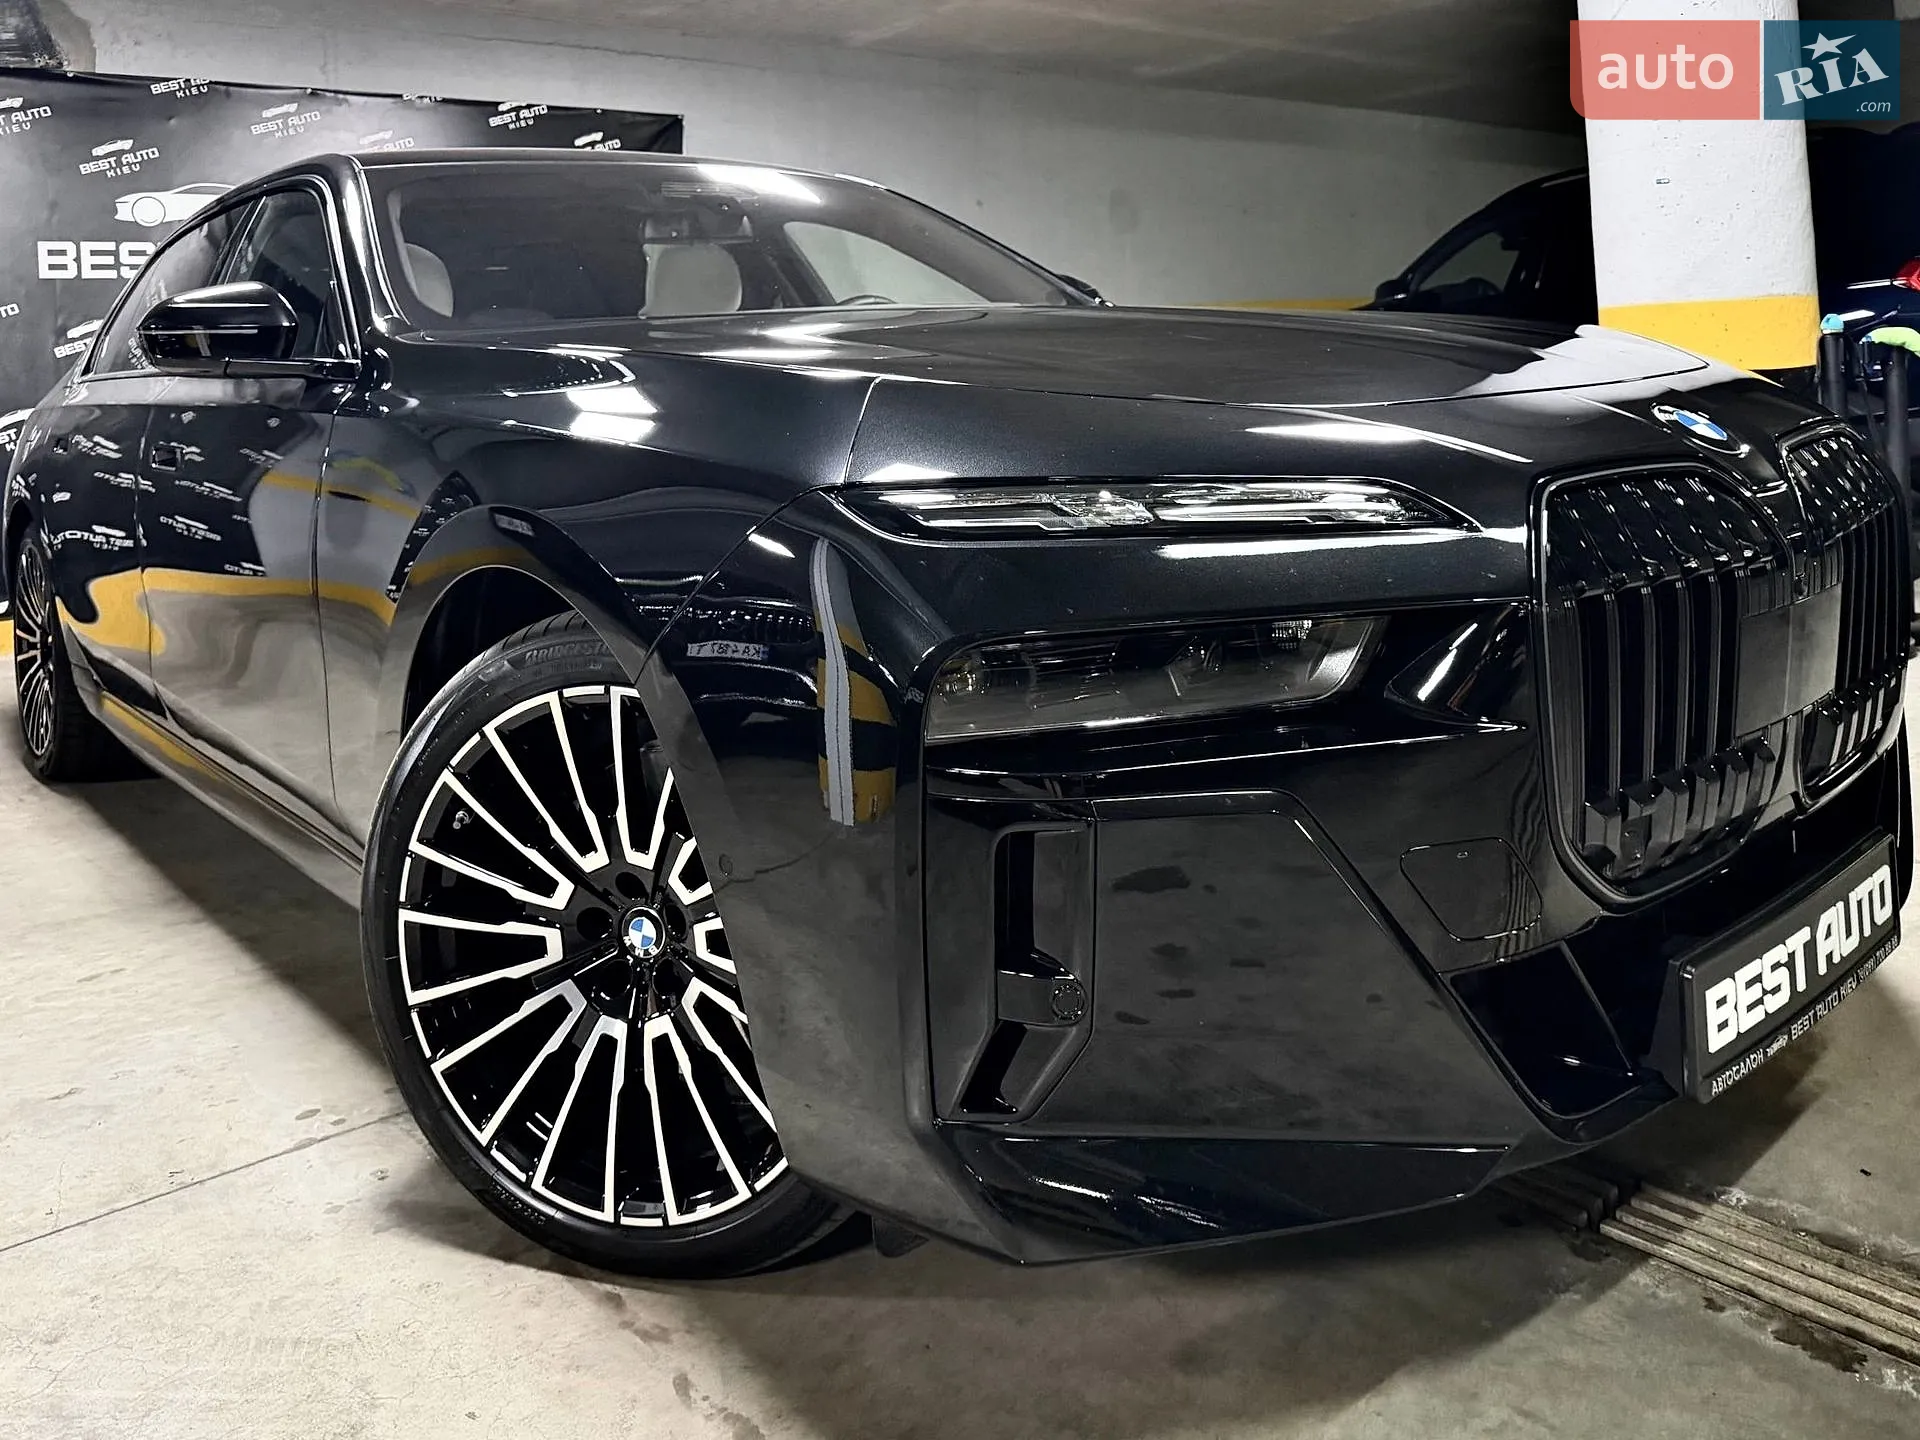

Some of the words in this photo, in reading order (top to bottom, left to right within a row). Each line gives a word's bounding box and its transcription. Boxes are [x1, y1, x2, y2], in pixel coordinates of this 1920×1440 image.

[11, 105, 52, 123] AUTO
[250, 119, 284, 135] BEST
[287, 111, 321, 128] AUTO
[488, 112, 518, 127] BEST
[520, 104, 548, 119] AUTO
[79, 153, 118, 175] BEST
[121, 147, 160, 167] AUTO
[37, 240, 159, 280] BES
[1705, 926, 1811, 1053] BEST
[1816, 864, 1893, 976] AUTO
[1790, 1010, 1815, 1041] BEST
[1816, 990, 1840, 1020] AUTO
